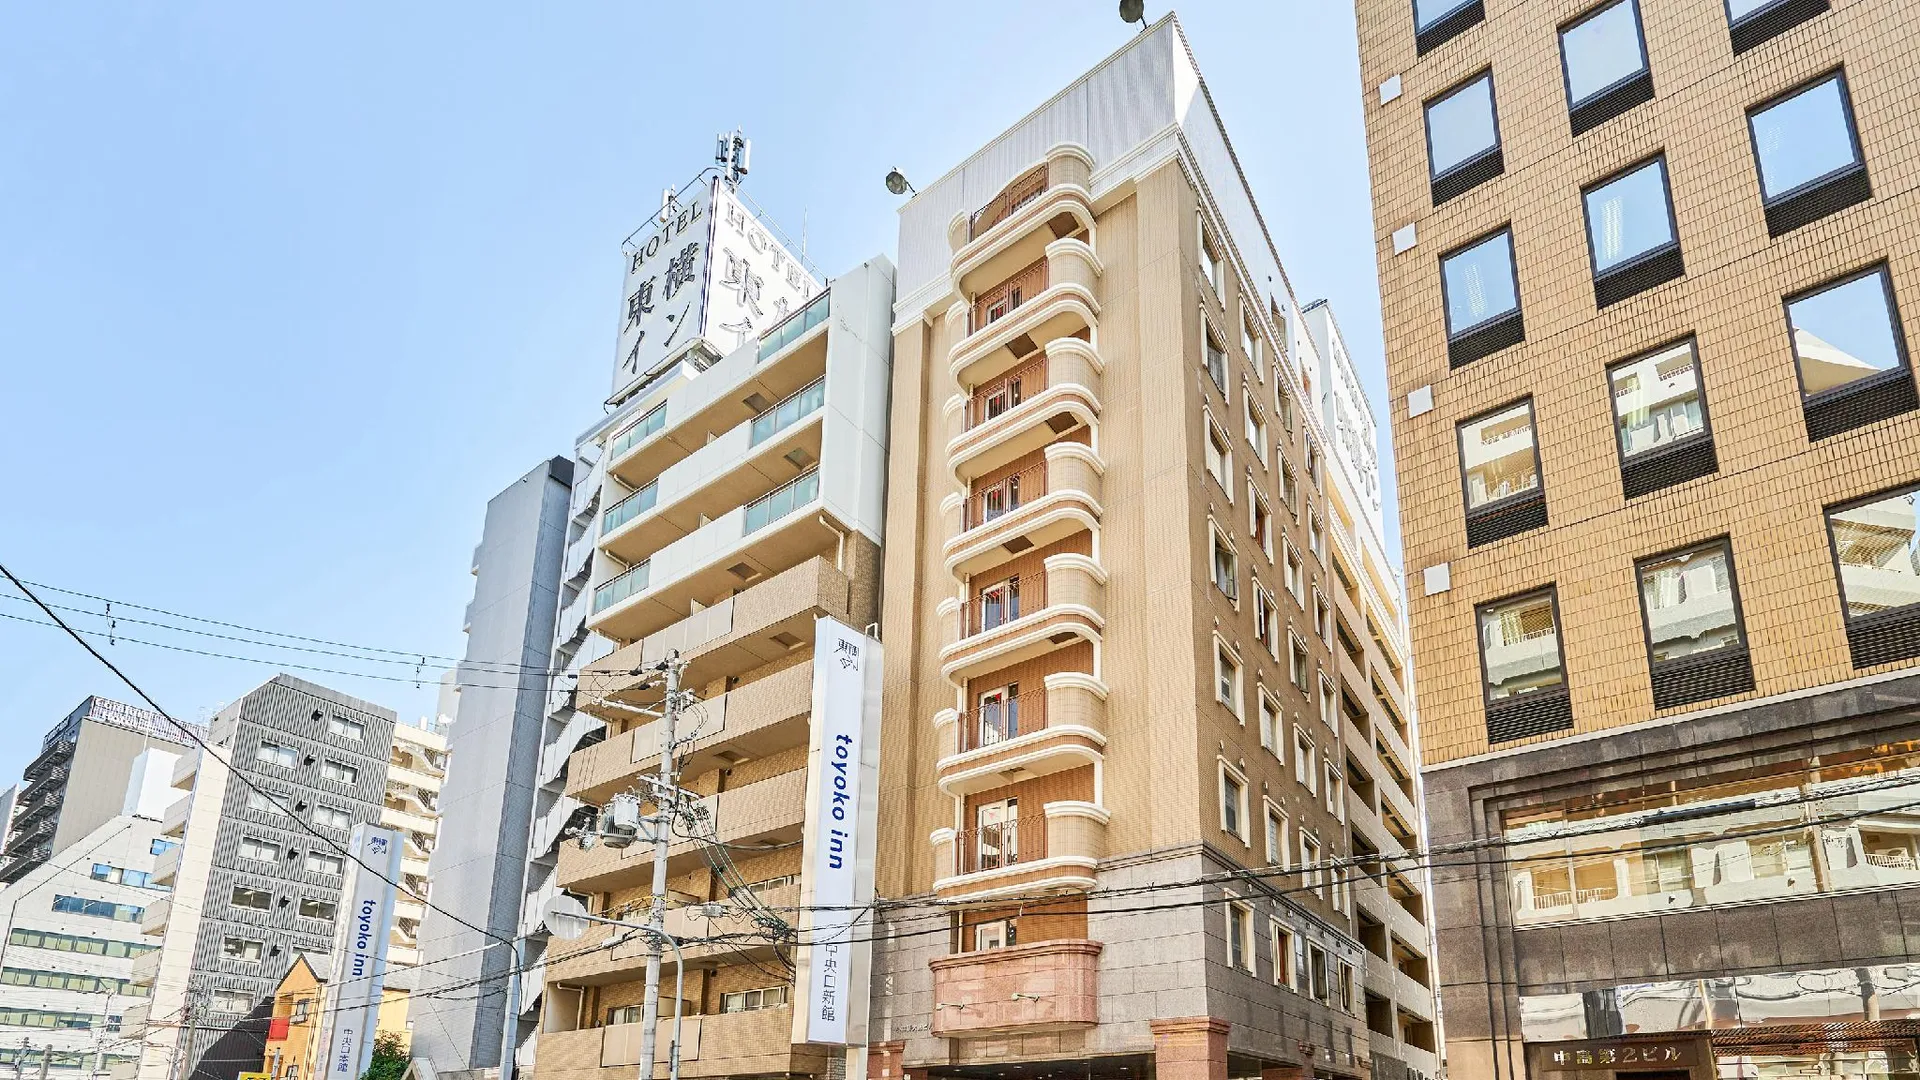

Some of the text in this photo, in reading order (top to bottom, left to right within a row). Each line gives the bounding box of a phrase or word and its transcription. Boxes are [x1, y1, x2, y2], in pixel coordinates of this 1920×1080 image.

[631, 200, 703, 275] HOTEL
[621, 301, 691, 375] イン
[829, 734, 853, 870] toyoko inn
[352, 899, 377, 976] toyoko inn
[821, 942, 838, 1022] 中央口新館
